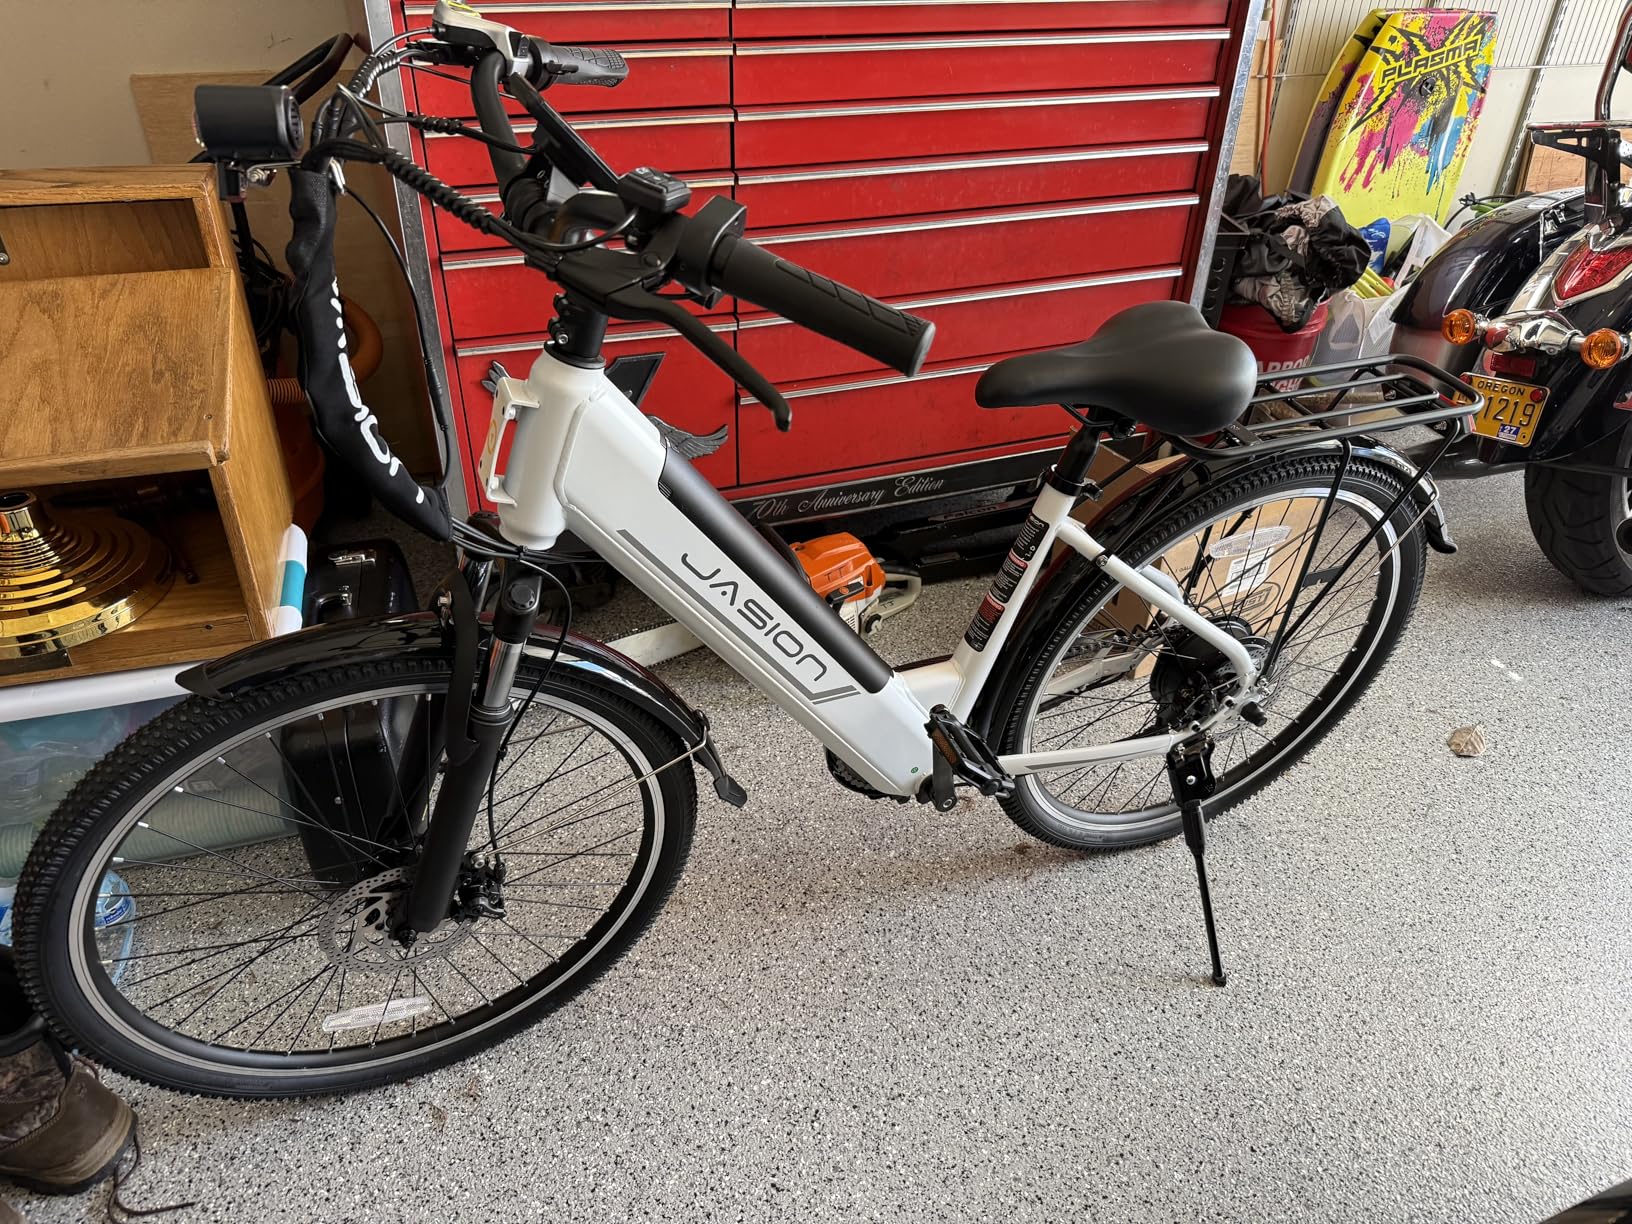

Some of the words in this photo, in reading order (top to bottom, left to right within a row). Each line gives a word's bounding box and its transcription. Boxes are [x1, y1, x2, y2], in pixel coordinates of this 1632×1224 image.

[1381, 36, 1481, 86] PLASMA
[1477, 380, 1526, 396] OREGON
[1483, 396, 1536, 427] 1219
[1503, 425, 1517, 435] 27
[752, 498, 789, 520] 70th
[797, 488, 887, 513] Anniversary
[893, 476, 944, 497] Edition
[681, 552, 828, 682] JASION
